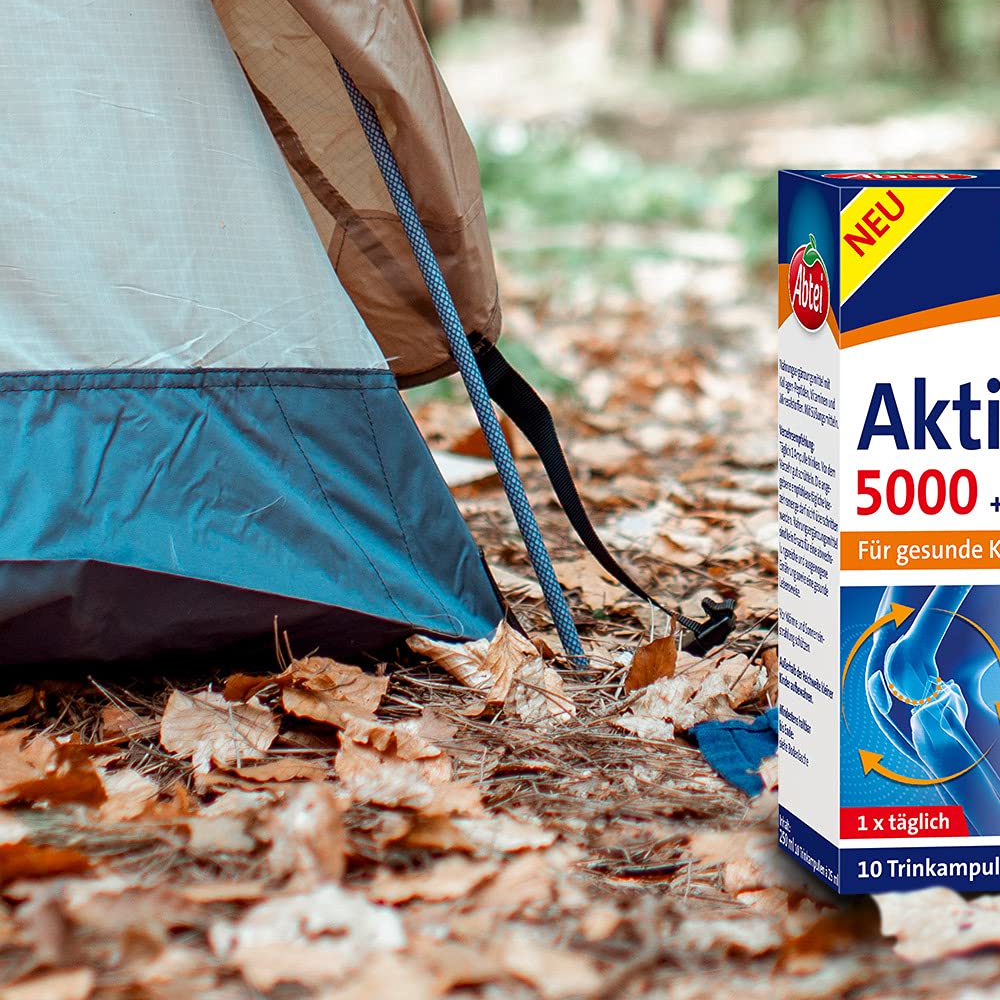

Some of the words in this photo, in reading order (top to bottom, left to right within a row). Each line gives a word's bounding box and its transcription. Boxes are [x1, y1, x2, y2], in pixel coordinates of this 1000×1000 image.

[844, 190, 905, 257] NEU
[792, 264, 824, 314] Abtei
[856, 468, 978, 516] 5000
[857, 539, 891, 561] Für
[896, 538, 983, 566] gesunde
[857, 815, 868, 830] 1
[873, 818, 884, 830] x
[888, 813, 950, 836] täglich
[857, 861, 882, 878] 10
